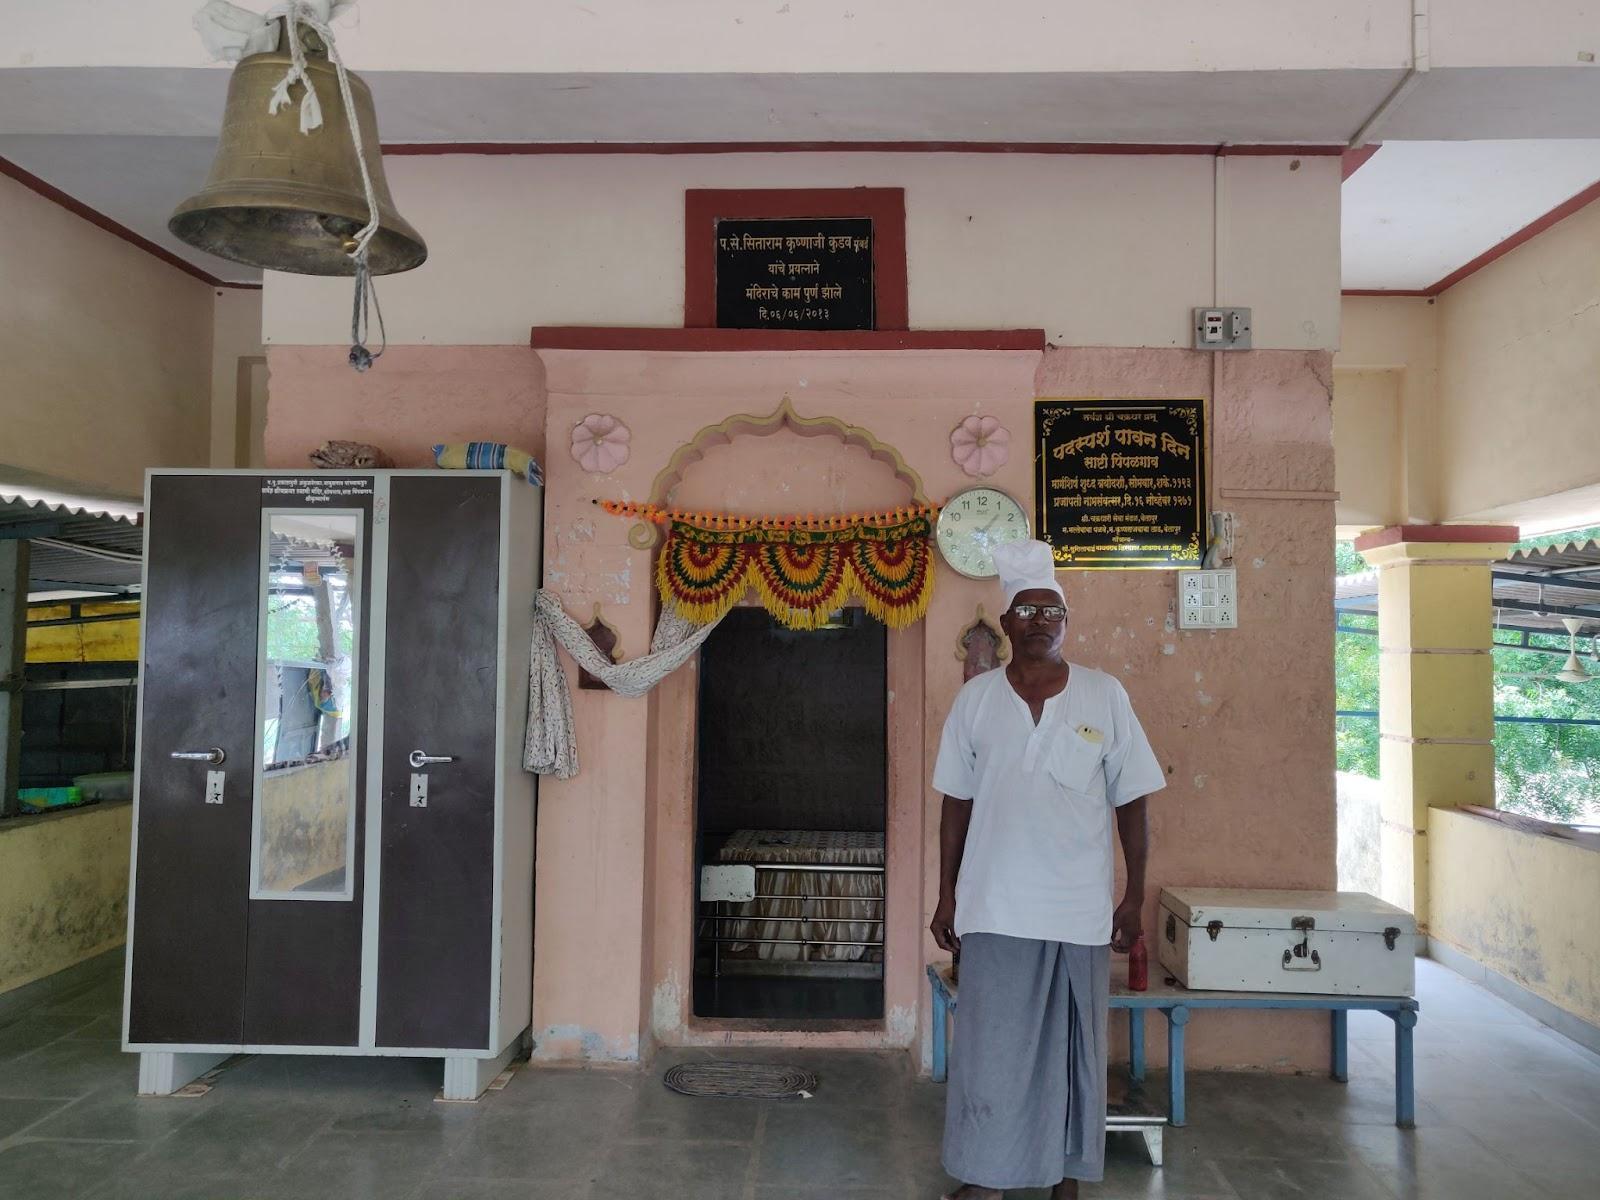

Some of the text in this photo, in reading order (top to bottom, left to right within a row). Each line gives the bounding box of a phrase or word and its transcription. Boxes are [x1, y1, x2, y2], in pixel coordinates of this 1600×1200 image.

[786, 232, 825, 254] कृष्णाजी
[828, 236, 852, 253] कुडव
[768, 260, 820, 275] यांचे प्रयत्नाने
[745, 283, 843, 303] मंदिराचे काम पुर्ण झाले
[1105, 412, 1114, 421] श्री
[1053, 425, 1191, 460] पदस्पर्श पावन दिन
[1111, 452, 1159, 469] पिंपळगाव
[977, 496, 988, 506] 12
[1053, 494, 1081, 507] प्रजापती
[962, 501, 970, 510] 11
[997, 501, 1001, 510] 1
[950, 512, 961, 521] 10
[1008, 513, 1014, 521] 2
[946, 528, 953, 537] 9
[1011, 529, 1018, 538] 3
[978, 561, 985, 570] 6
